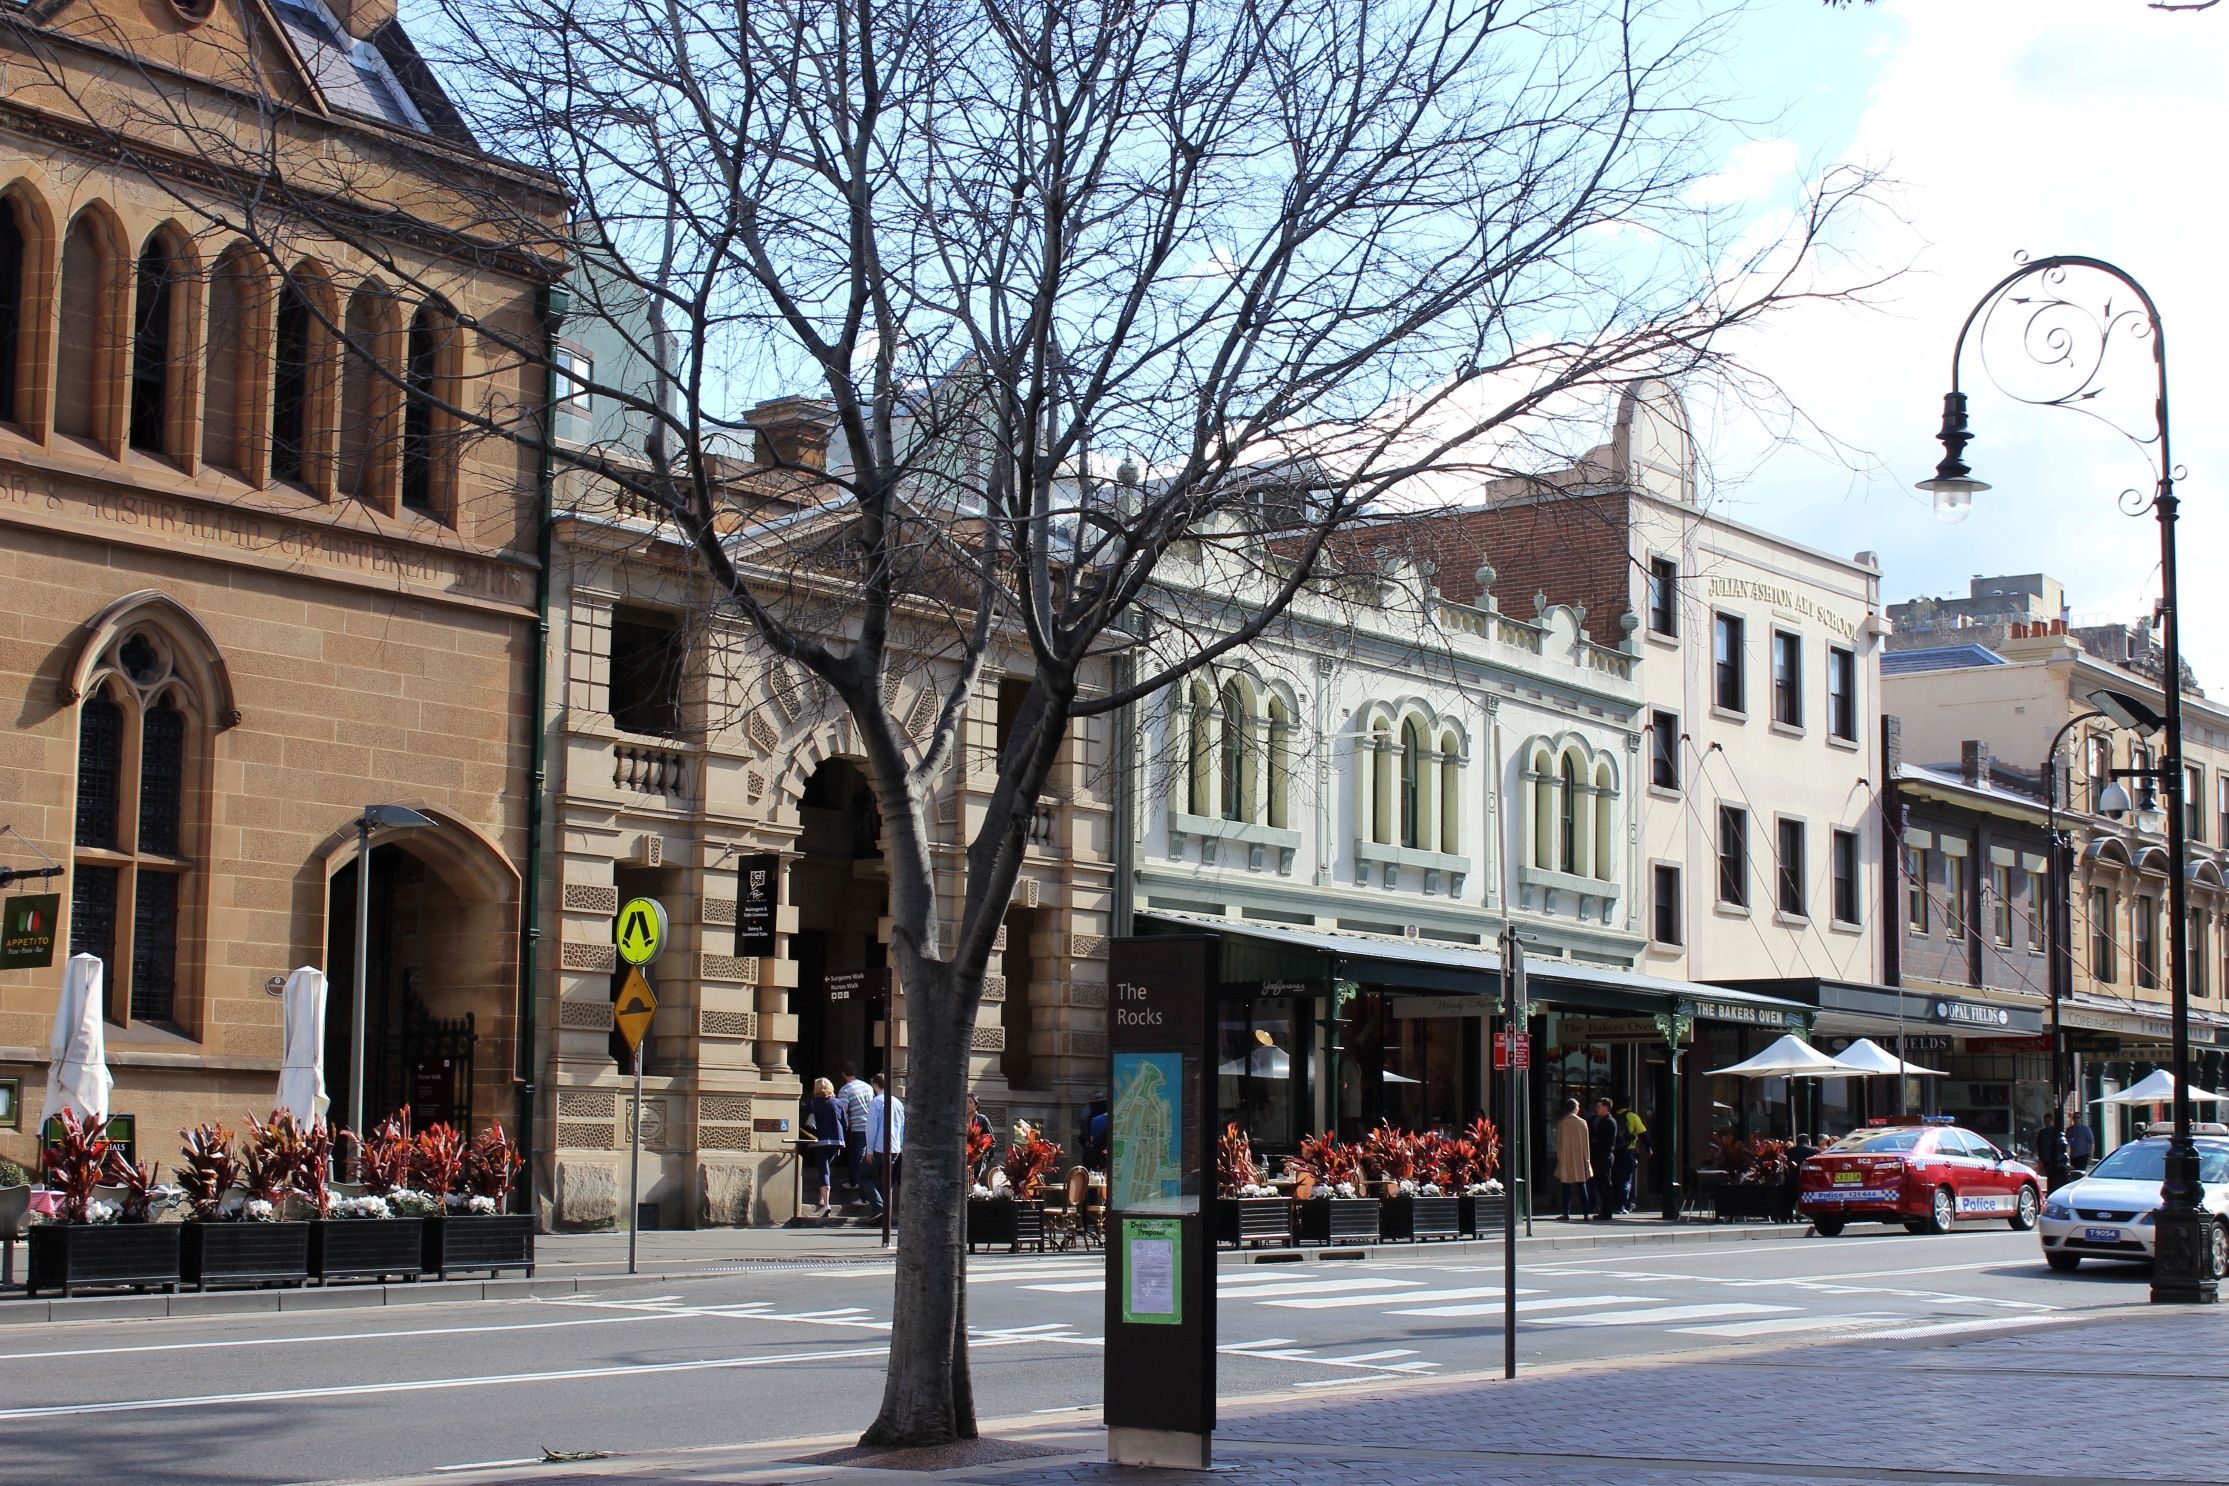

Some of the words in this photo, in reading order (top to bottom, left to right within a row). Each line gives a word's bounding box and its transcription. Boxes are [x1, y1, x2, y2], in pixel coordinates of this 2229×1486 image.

[81, 490, 262, 549] AUSTRALIAN
[279, 528, 439, 582] CHARTERED
[1708, 577, 1750, 599] JULIAN
[1750, 582, 1794, 609] ASHTON
[1795, 593, 1815, 617] ART
[1817, 602, 1859, 642] SCHOOL
[6, 937, 49, 948] APPETITO
[852, 972, 865, 980] Walk
[1117, 983, 1147, 1000] The
[1433, 997, 1470, 1015] Wendy
[1696, 1002, 1716, 1017] THE
[1718, 1006, 1756, 1021] BAKERS
[1759, 1010, 1783, 1025] OVEN
[1948, 1003, 1970, 1019] OPAL
[1971, 1006, 1998, 1023] FIELDS
[1117, 1007, 1163, 1025] Rocks
[1562, 1023, 1584, 1033] The
[1588, 1022, 1624, 1032] Bakers
[1628, 1021, 1656, 1032] Oven
[1836, 1173, 1843, 1181] CA
[1962, 1197, 1996, 1211] Police
[1138, 1229, 1166, 1238] Proposal
